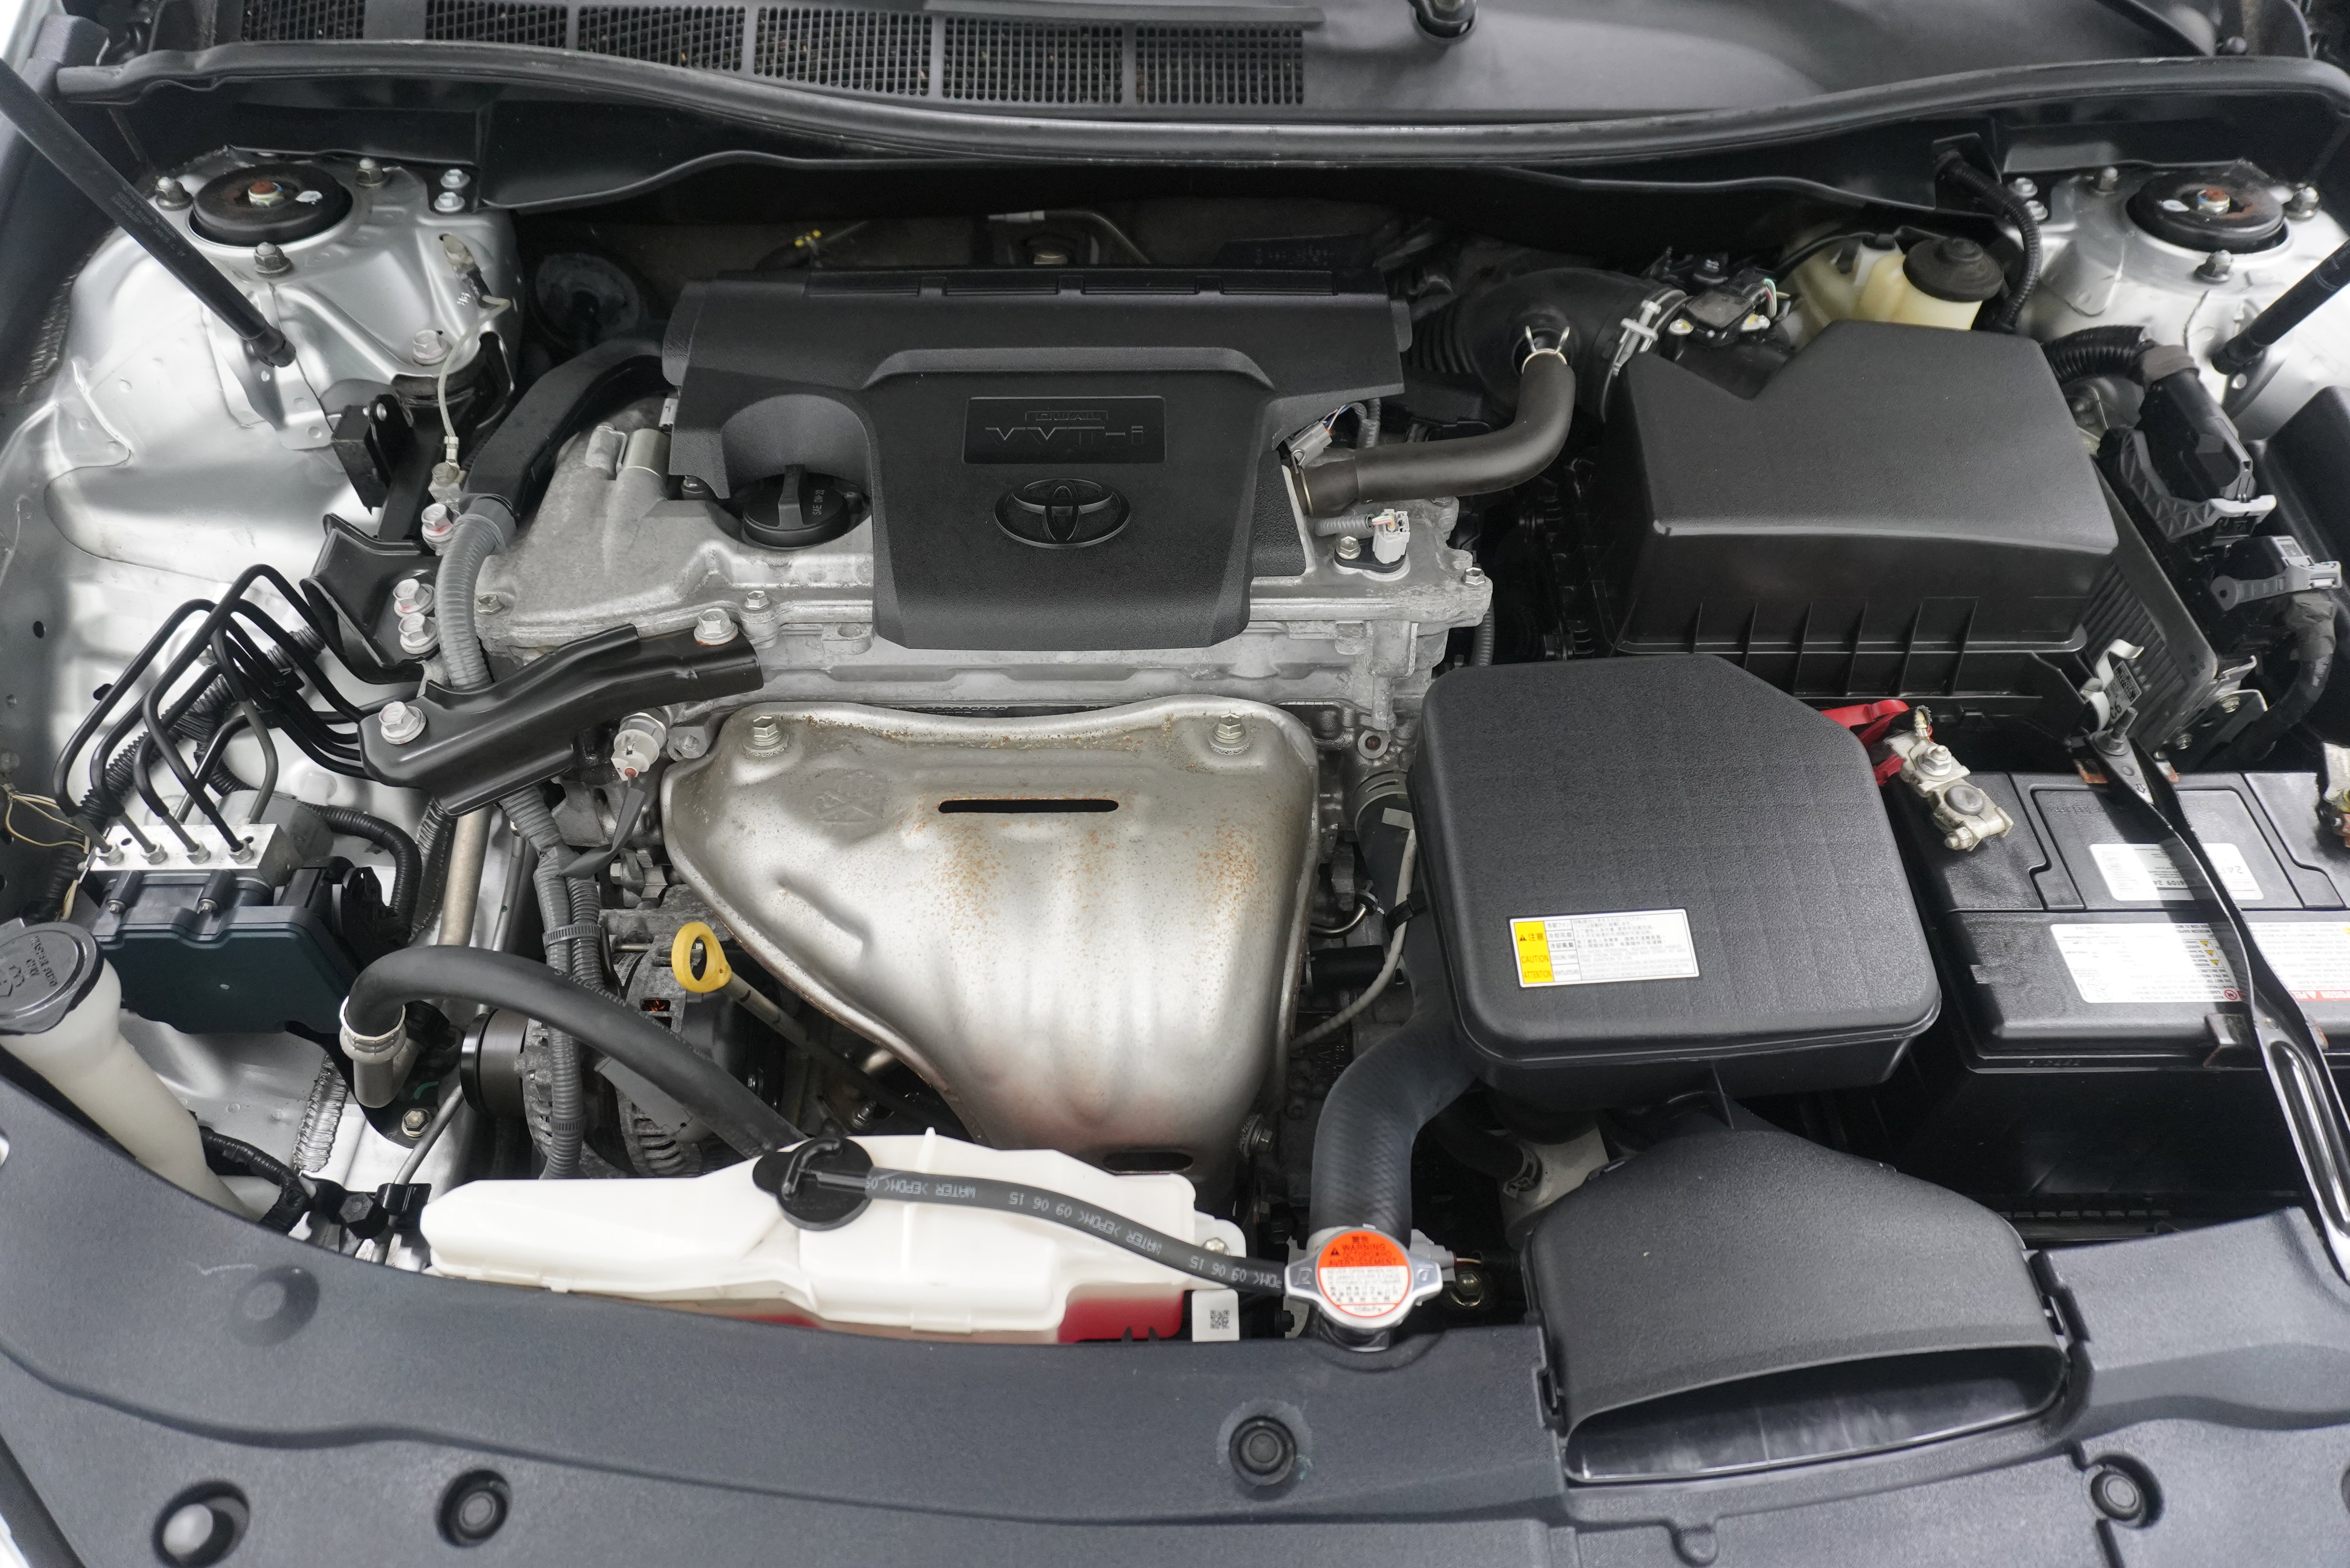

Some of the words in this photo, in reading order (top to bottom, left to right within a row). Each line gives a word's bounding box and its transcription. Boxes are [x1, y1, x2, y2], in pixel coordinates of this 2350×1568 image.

[985, 426, 1144, 446] VVT-i
[813, 489, 825, 503] 0W-20
[812, 505, 822, 516] SAE
[1521, 955, 1549, 964] CAUTION
[1524, 970, 1552, 979] ATTENTION
[935, 1182, 976, 1199] WATER
[1008, 1191, 1025, 1206] 15
[1033, 1196, 1050, 1211] 06
[1055, 1203, 1073, 1218] 09
[1125, 1228, 1163, 1256] WATER
[1188, 1255, 1205, 1271] 15
[1211, 1261, 1226, 1277] 06
[1329, 1258, 1397, 1266] AVERTISSEMENT
[1231, 1266, 1247, 1283] 09
